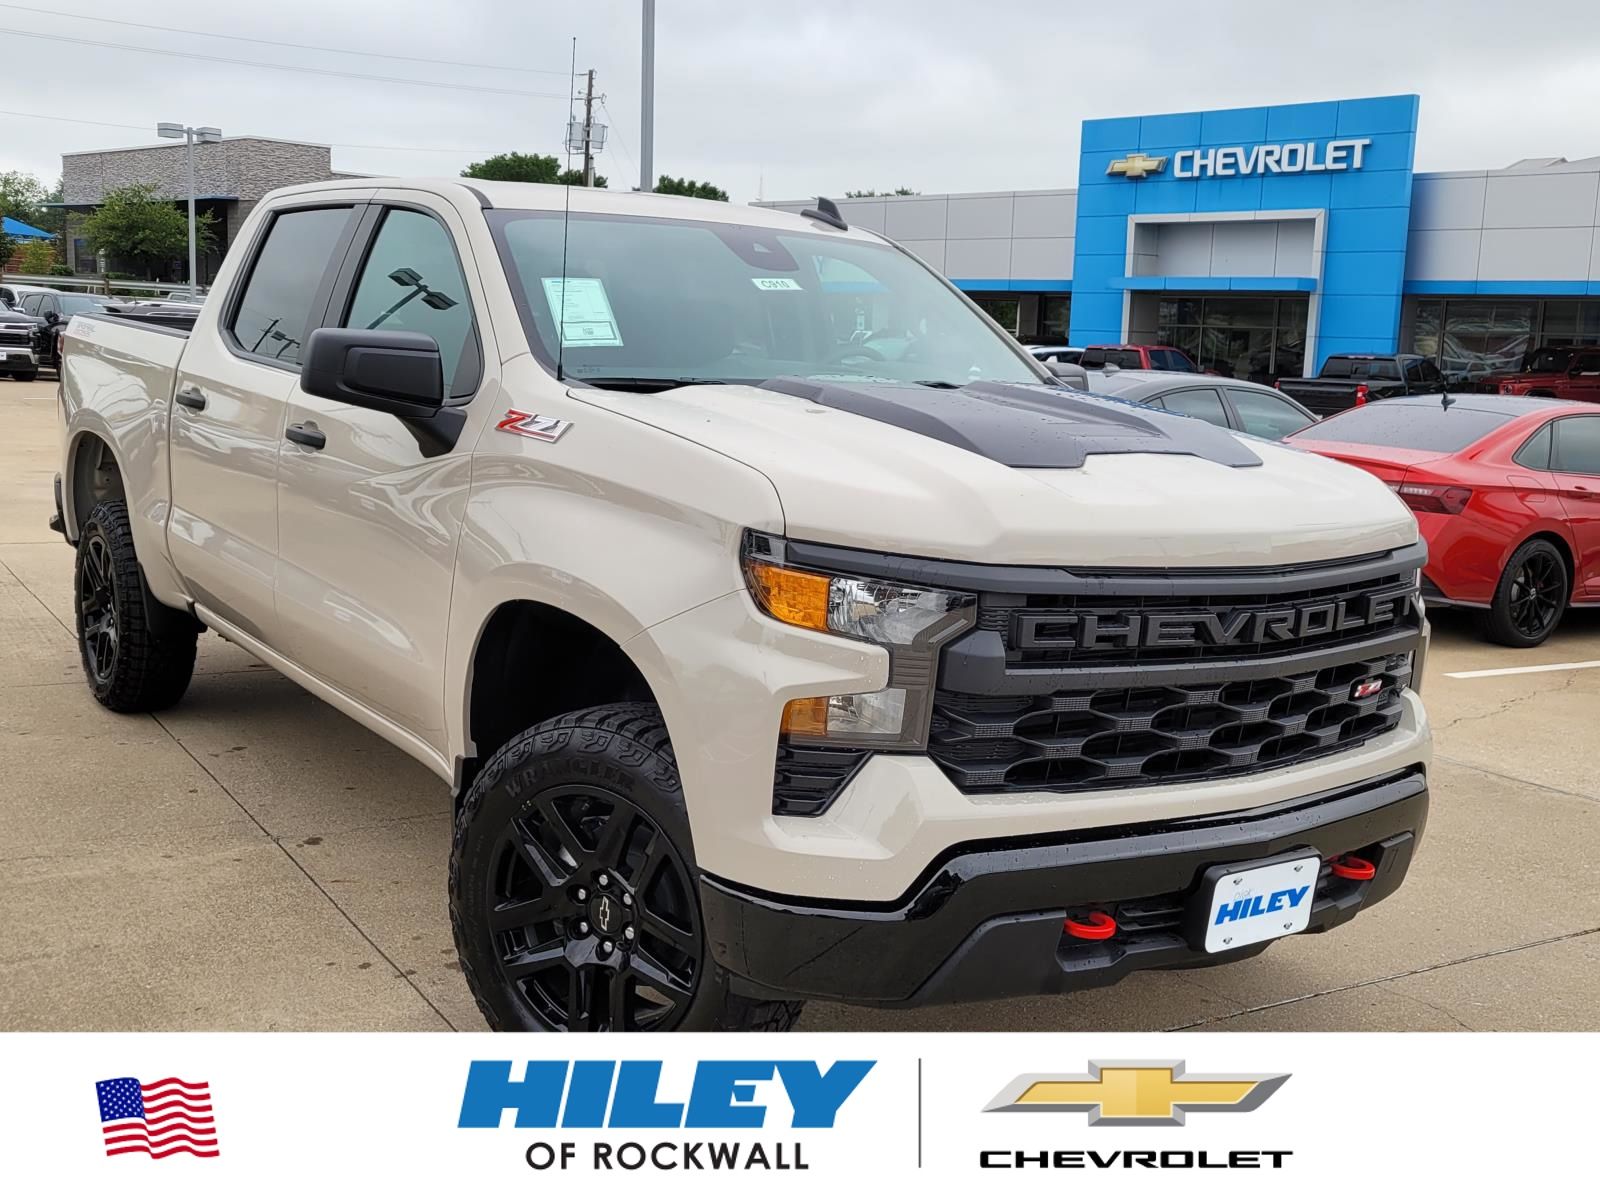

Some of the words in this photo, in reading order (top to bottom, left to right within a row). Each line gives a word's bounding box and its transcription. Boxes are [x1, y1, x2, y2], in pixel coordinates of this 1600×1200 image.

[1173, 138, 1371, 178] CHEVROLET
[495, 408, 573, 443] Z71
[1012, 585, 1416, 650] CHEVROLET
[504, 758, 637, 798] WRANGLER
[1214, 885, 1310, 926] HILEY
